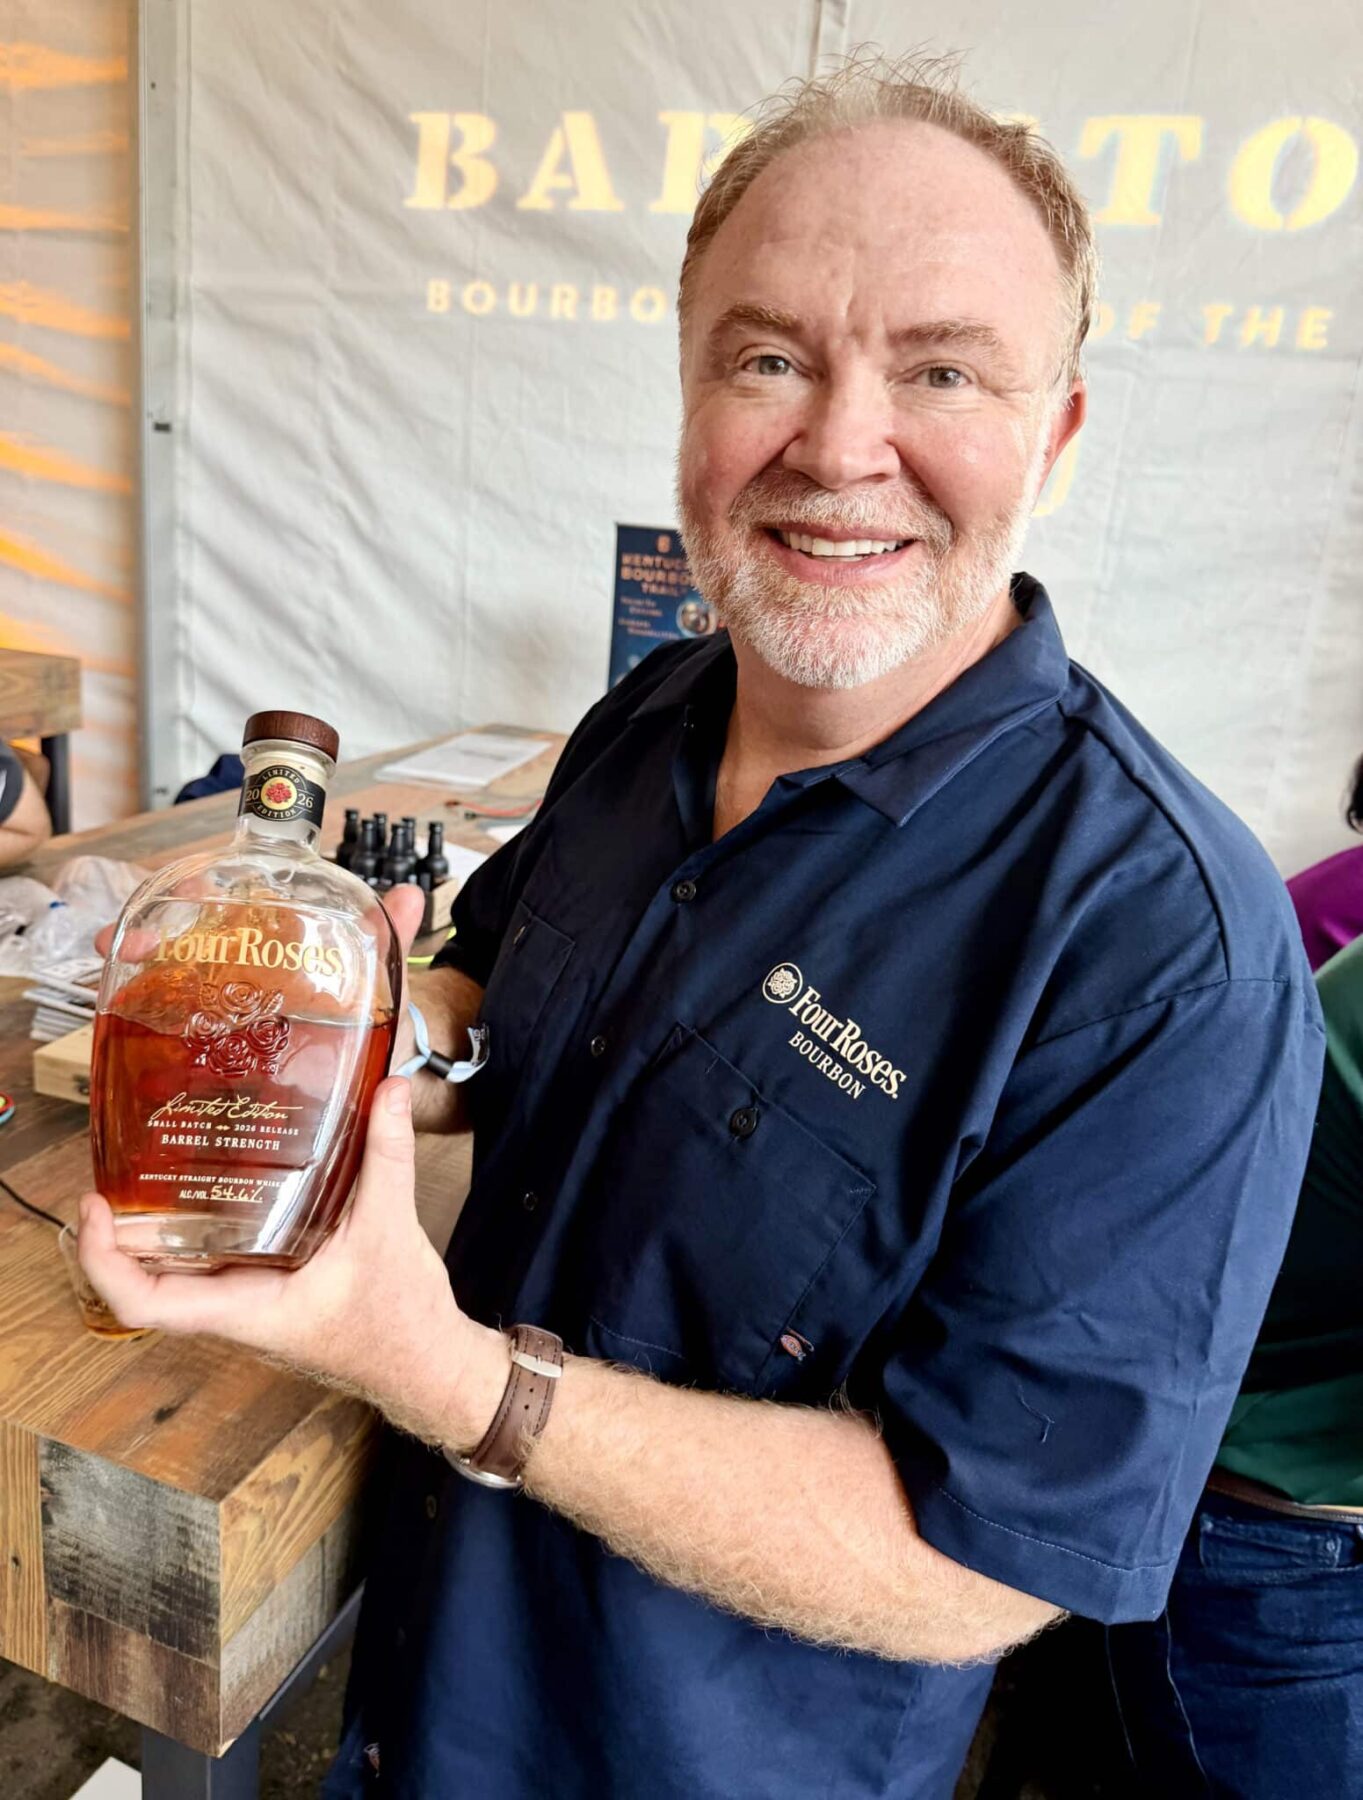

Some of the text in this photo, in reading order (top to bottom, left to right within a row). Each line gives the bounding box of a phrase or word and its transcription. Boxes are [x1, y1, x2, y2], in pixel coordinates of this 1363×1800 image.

[425, 279, 669, 324] BOURBO
[1202, 302, 1333, 349] THE
[262, 768, 300, 785] LIMITED
[246, 789, 314, 809] 20 26
[256, 804, 297, 819] EDITION
[788, 986, 844, 1042] Four
[788, 1031, 866, 1099] BOURBON
[150, 1092, 304, 1120] Limited Edition
[147, 1119, 178, 1128] SMALL
[180, 1120, 212, 1130] BATCH
[260, 1125, 300, 1136] RELEASE
[161, 1134, 281, 1151] BARREL STRENGTH
[139, 1173, 178, 1182] KENTUCKY
[178, 1174, 217, 1184] STRAIGHT
[218, 1176, 254, 1186] BOURBON
